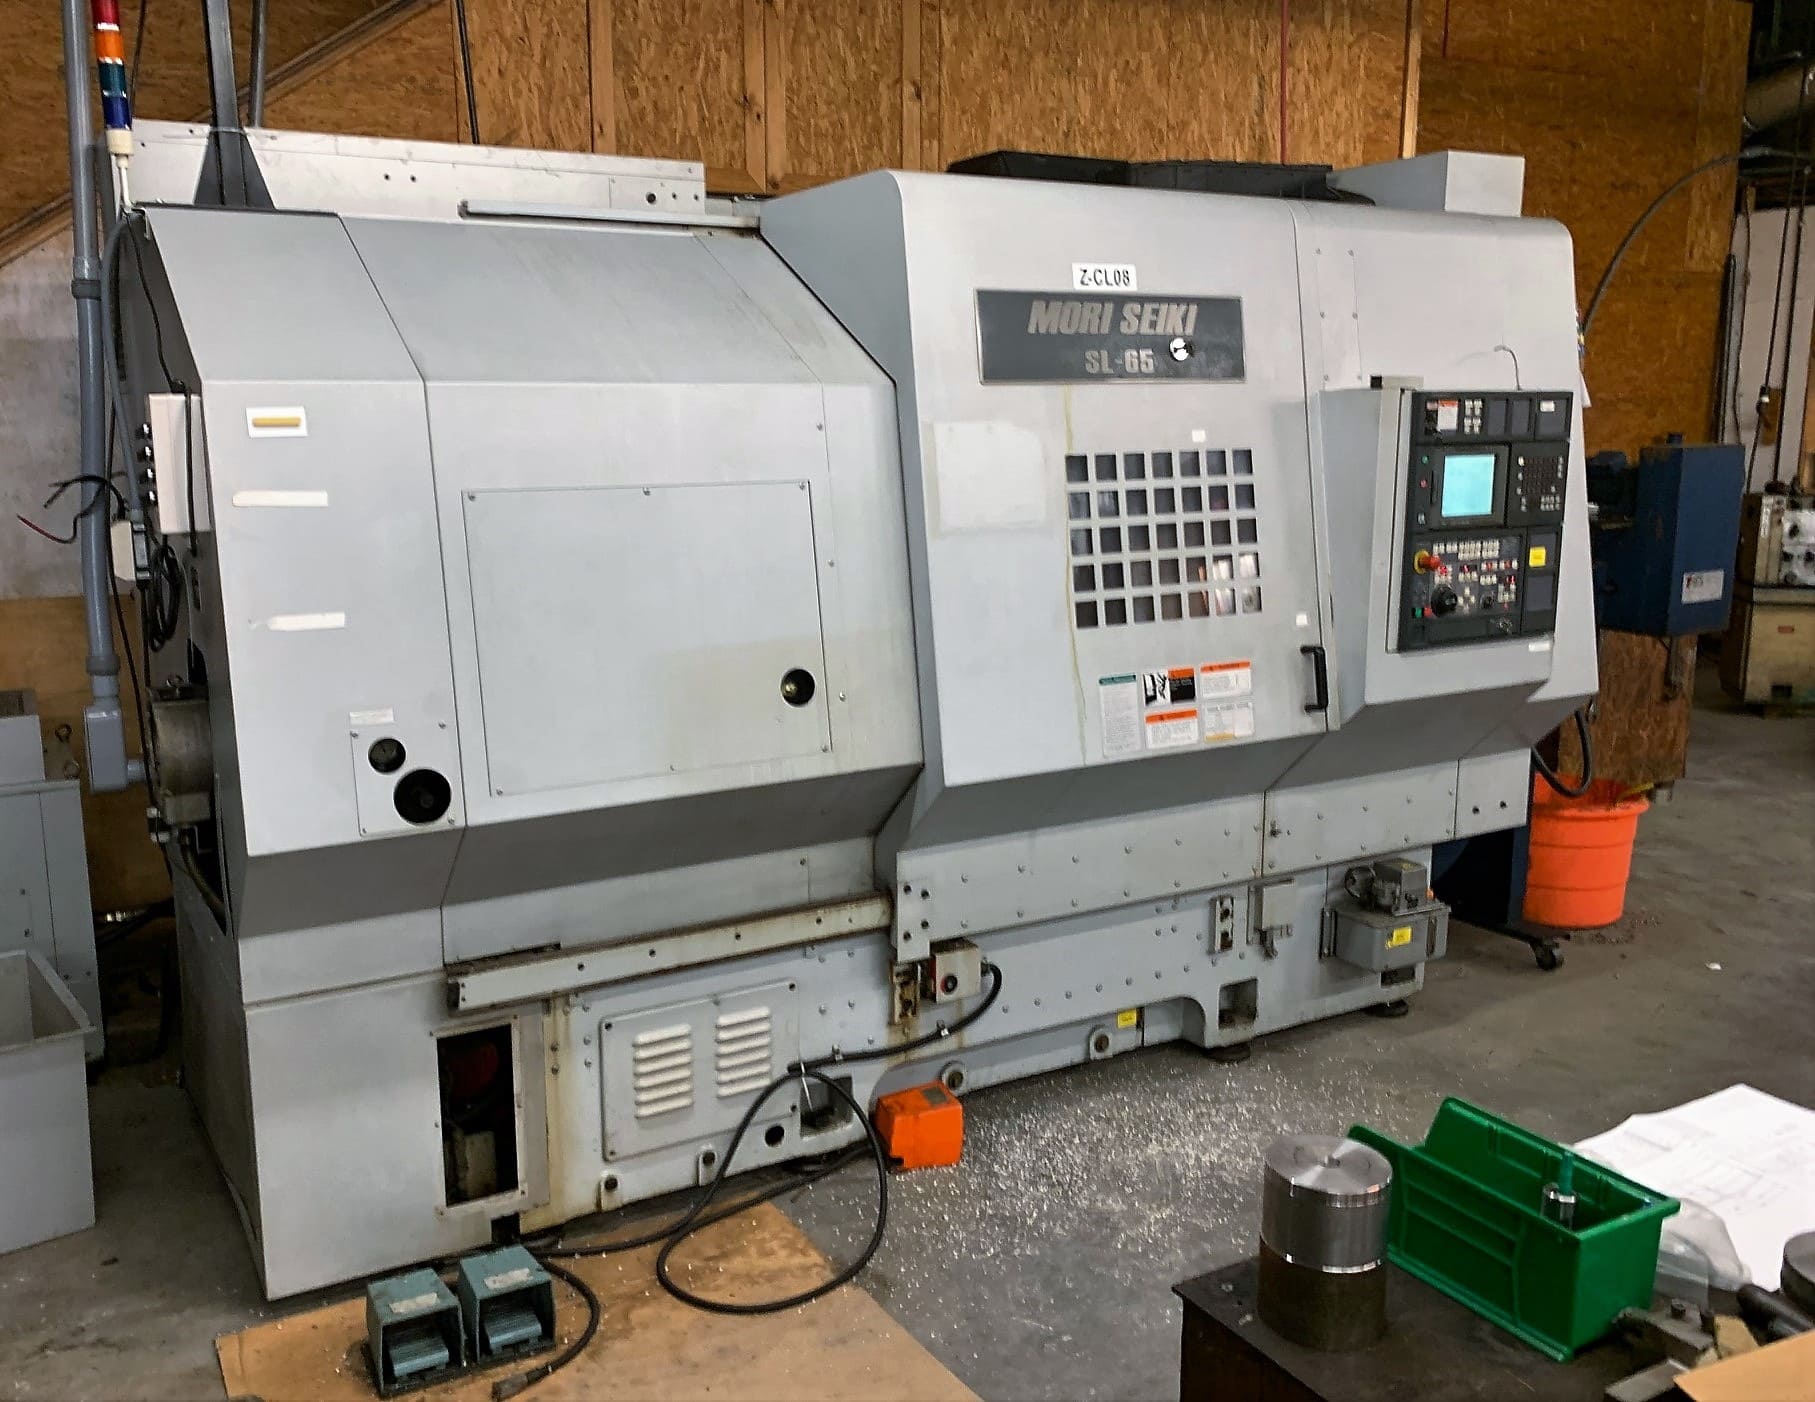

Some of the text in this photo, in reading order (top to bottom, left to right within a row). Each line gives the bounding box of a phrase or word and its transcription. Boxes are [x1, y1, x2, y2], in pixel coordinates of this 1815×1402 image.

[1080, 268, 1130, 286] Z-CL08
[1028, 300, 1198, 336] MORI SEIKI
